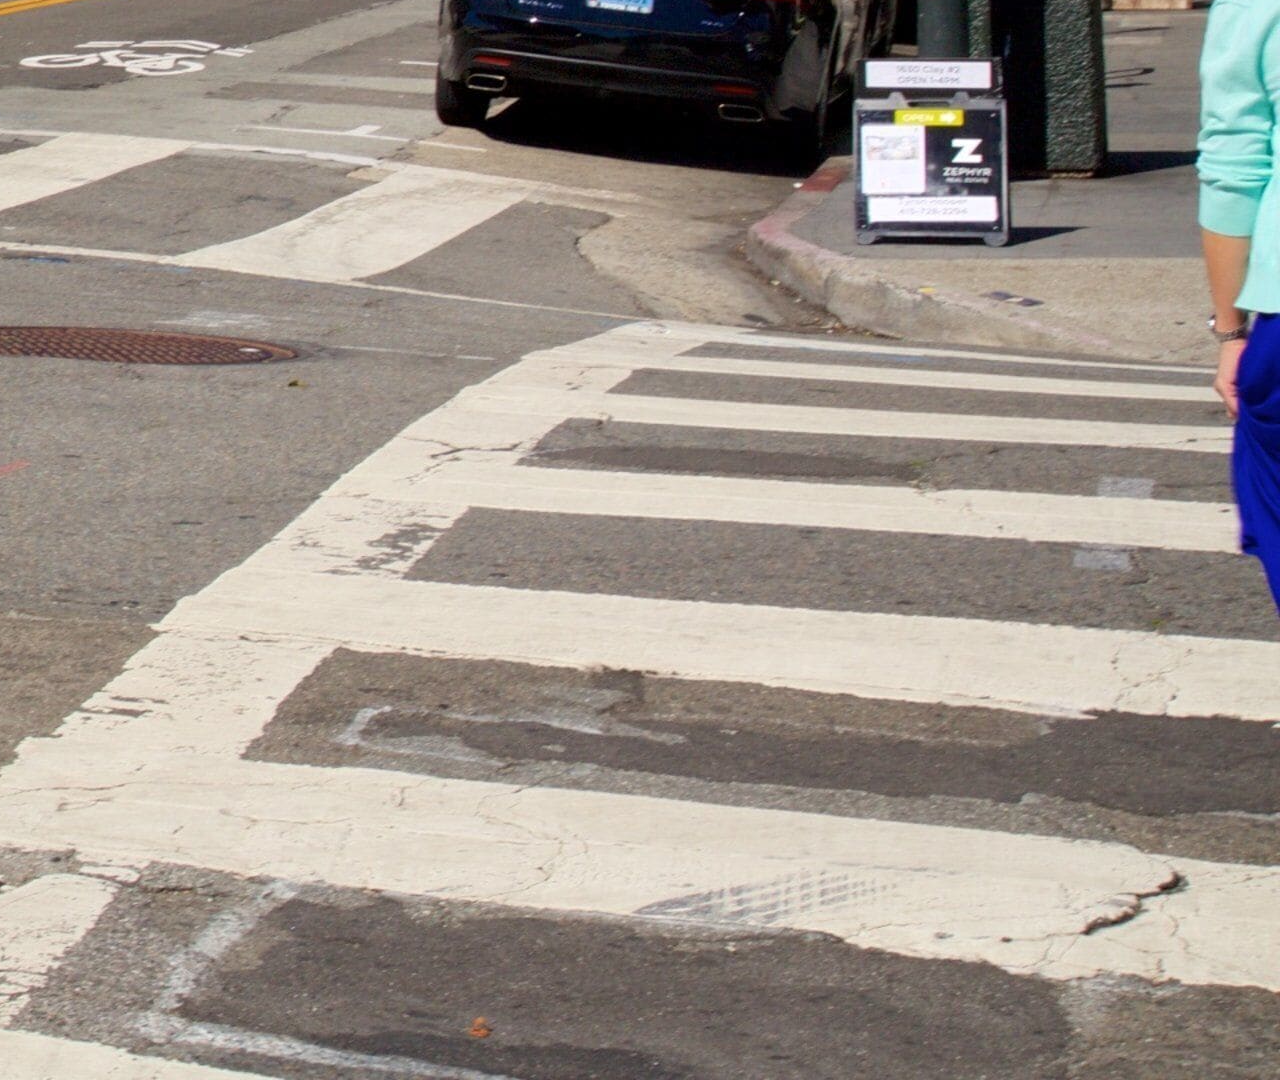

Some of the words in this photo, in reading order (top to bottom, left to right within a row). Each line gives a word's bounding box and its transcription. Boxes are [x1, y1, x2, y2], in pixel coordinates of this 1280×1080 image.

[902, 113, 935, 122] OPEN
[951, 138, 983, 164] Z
[942, 166, 993, 178] ZEPHYR
